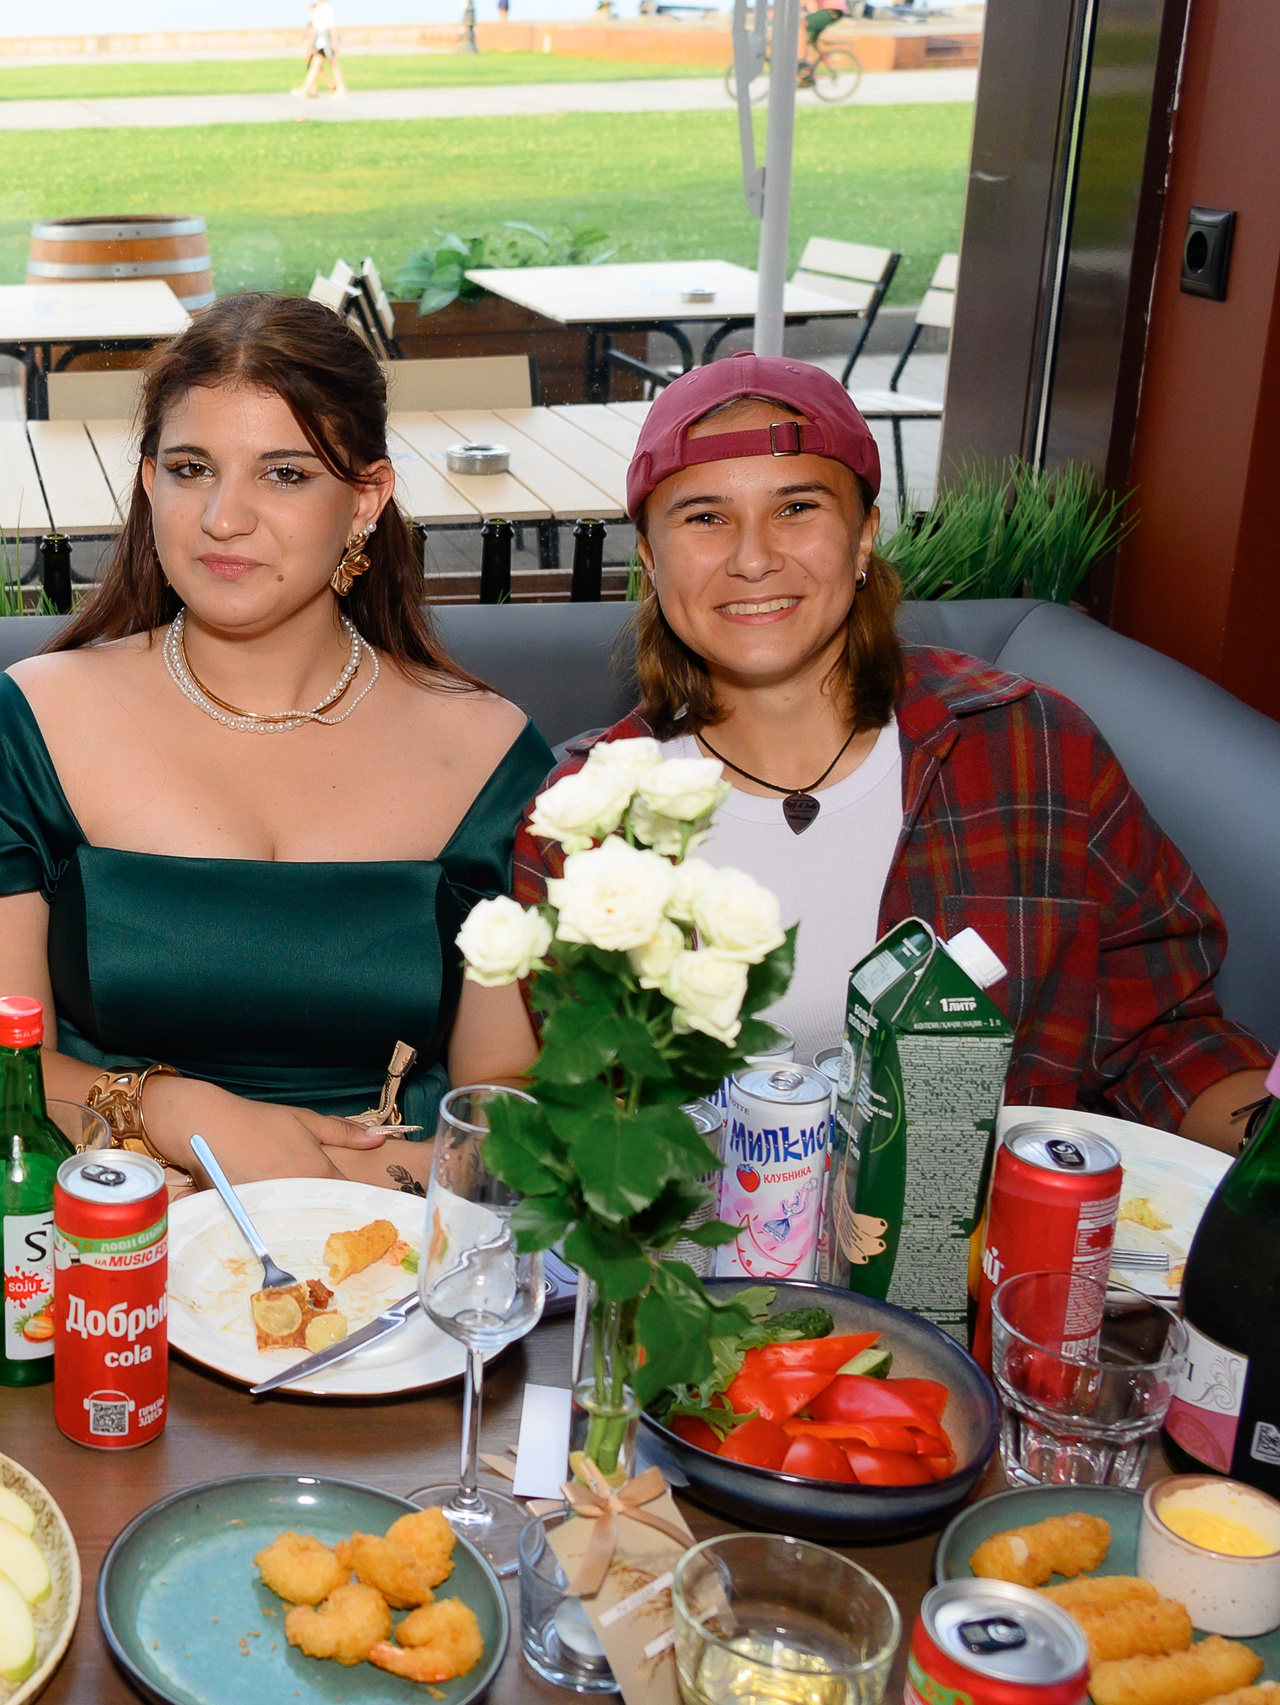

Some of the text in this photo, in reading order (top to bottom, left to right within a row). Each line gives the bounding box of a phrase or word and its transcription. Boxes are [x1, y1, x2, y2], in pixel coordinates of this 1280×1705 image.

[730, 1098, 750, 1116] OTTE
[729, 1117, 826, 1167] МИЛКИС
[763, 1166, 812, 1184] КЛУБНИКА
[108, 1250, 153, 1268] MUSIC
[8, 1279, 37, 1293] soju
[104, 1344, 152, 1368] cola
